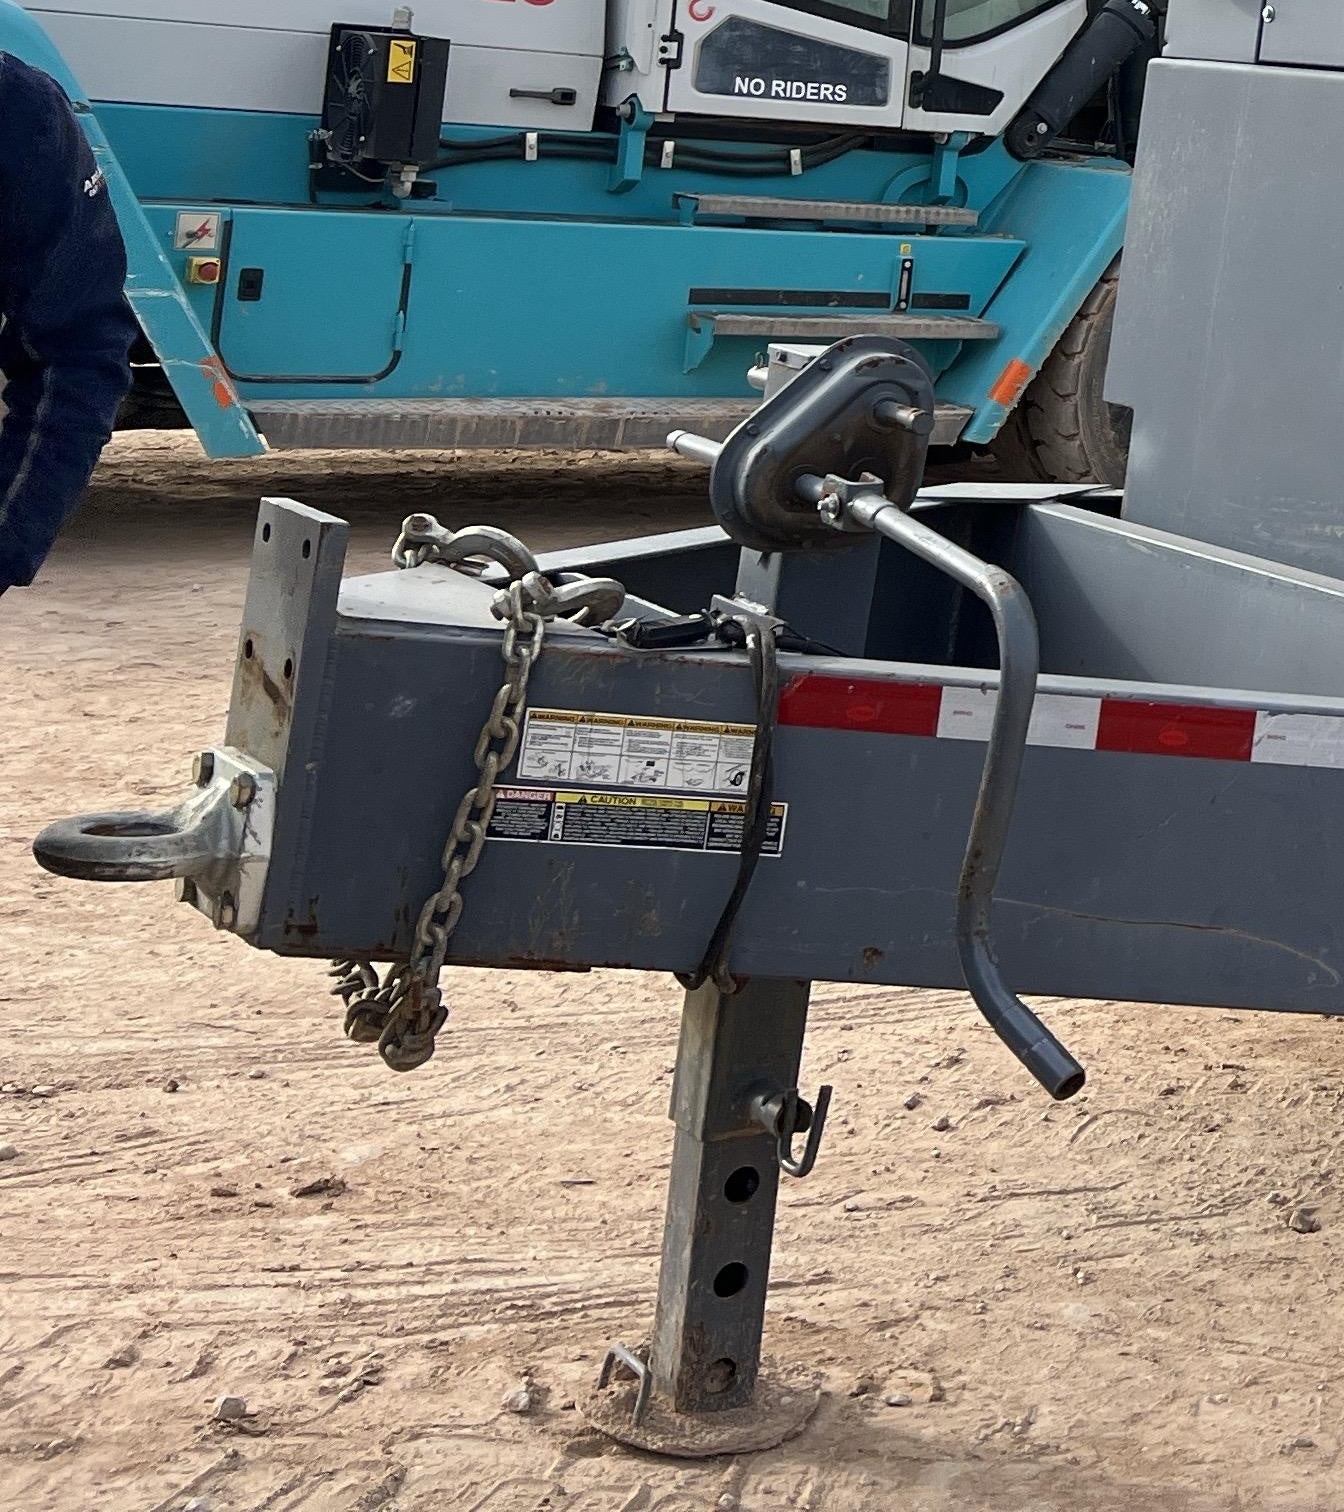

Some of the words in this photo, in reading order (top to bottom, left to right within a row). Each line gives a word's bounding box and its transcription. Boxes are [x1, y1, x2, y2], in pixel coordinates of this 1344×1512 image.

[733, 76, 766, 96] NO
[770, 80, 848, 103] RIDERS
[590, 795, 637, 805] CAUTION
